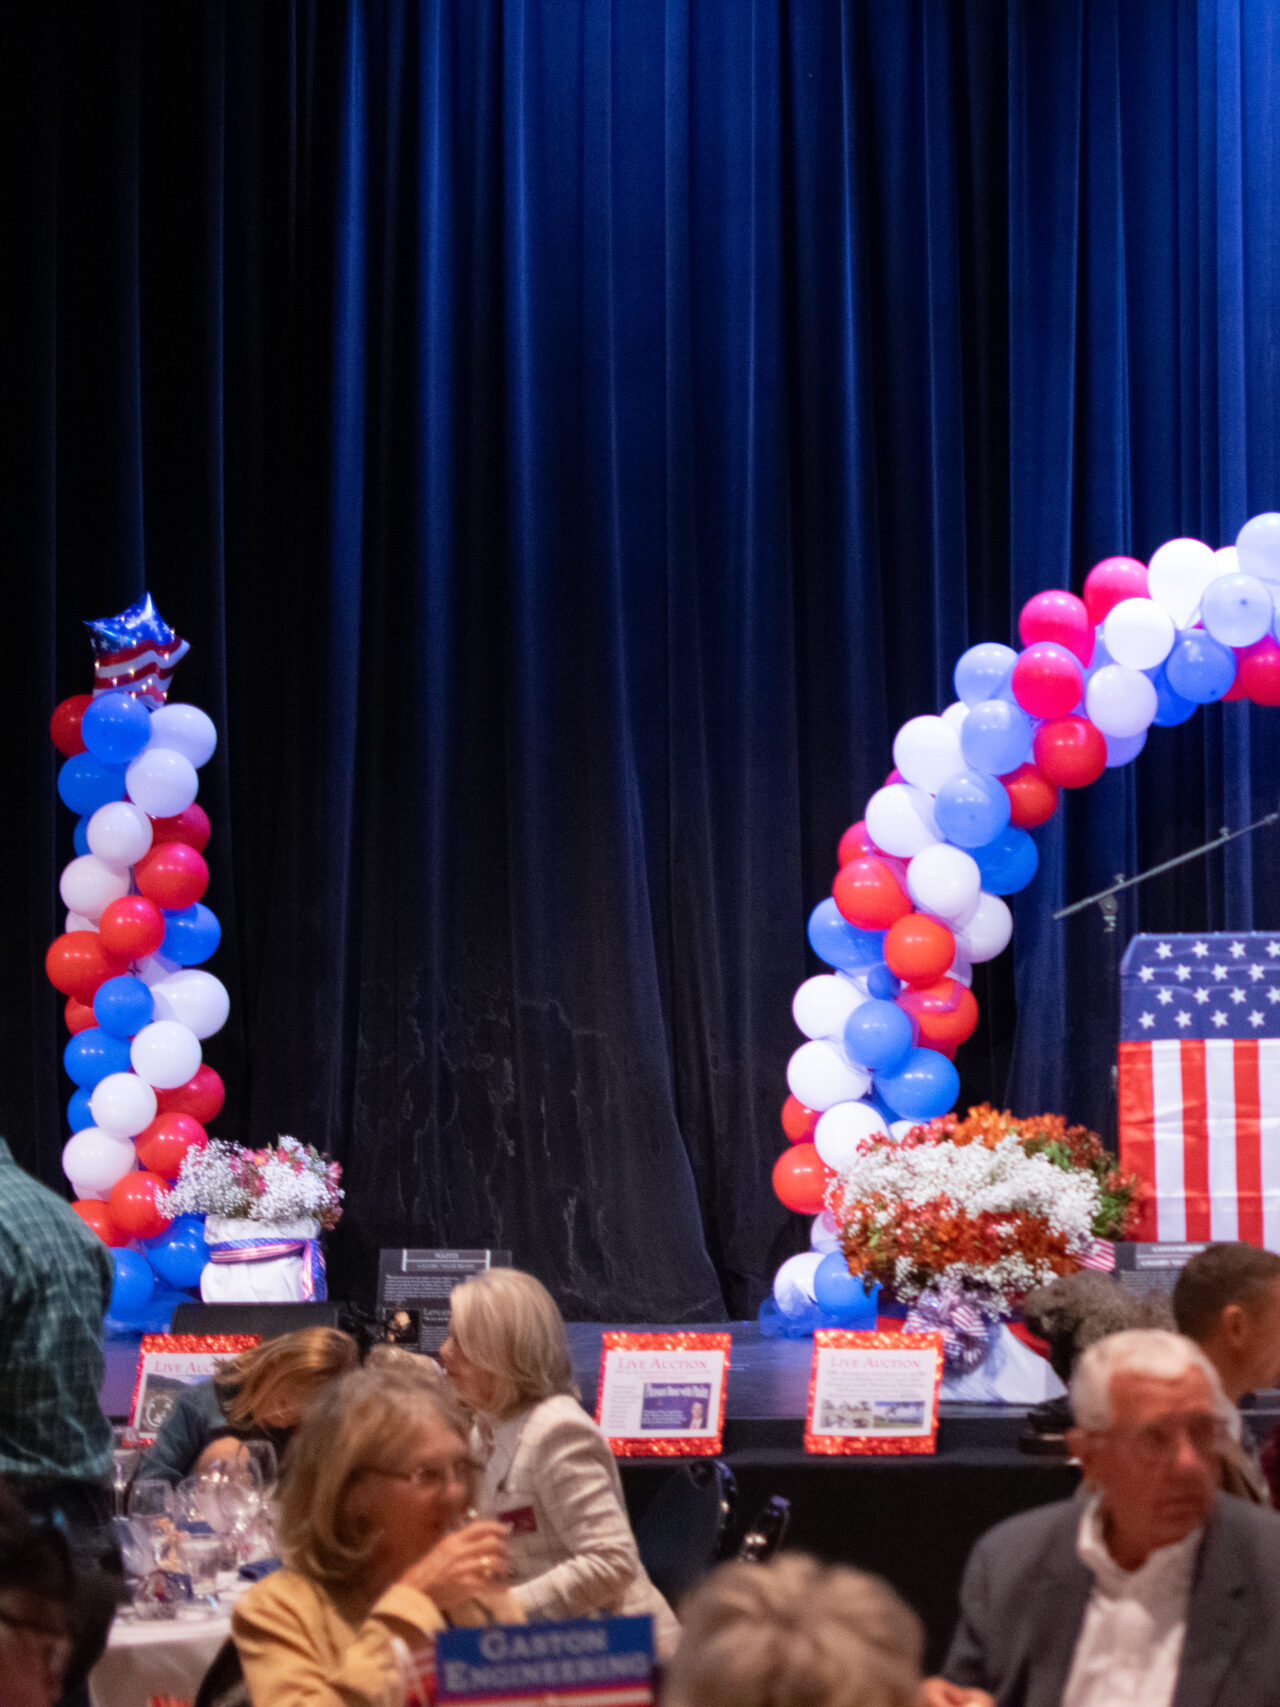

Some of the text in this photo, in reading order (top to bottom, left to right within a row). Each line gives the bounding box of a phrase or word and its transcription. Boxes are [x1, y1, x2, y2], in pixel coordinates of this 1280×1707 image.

[155, 1360, 182, 1373] LIVE
[617, 1357, 708, 1370] LIVE AUCTION
[830, 1356, 921, 1369] LIVE AUCTION
[479, 1629, 608, 1661] GASTON
[444, 1652, 649, 1692] ENGINEERING
